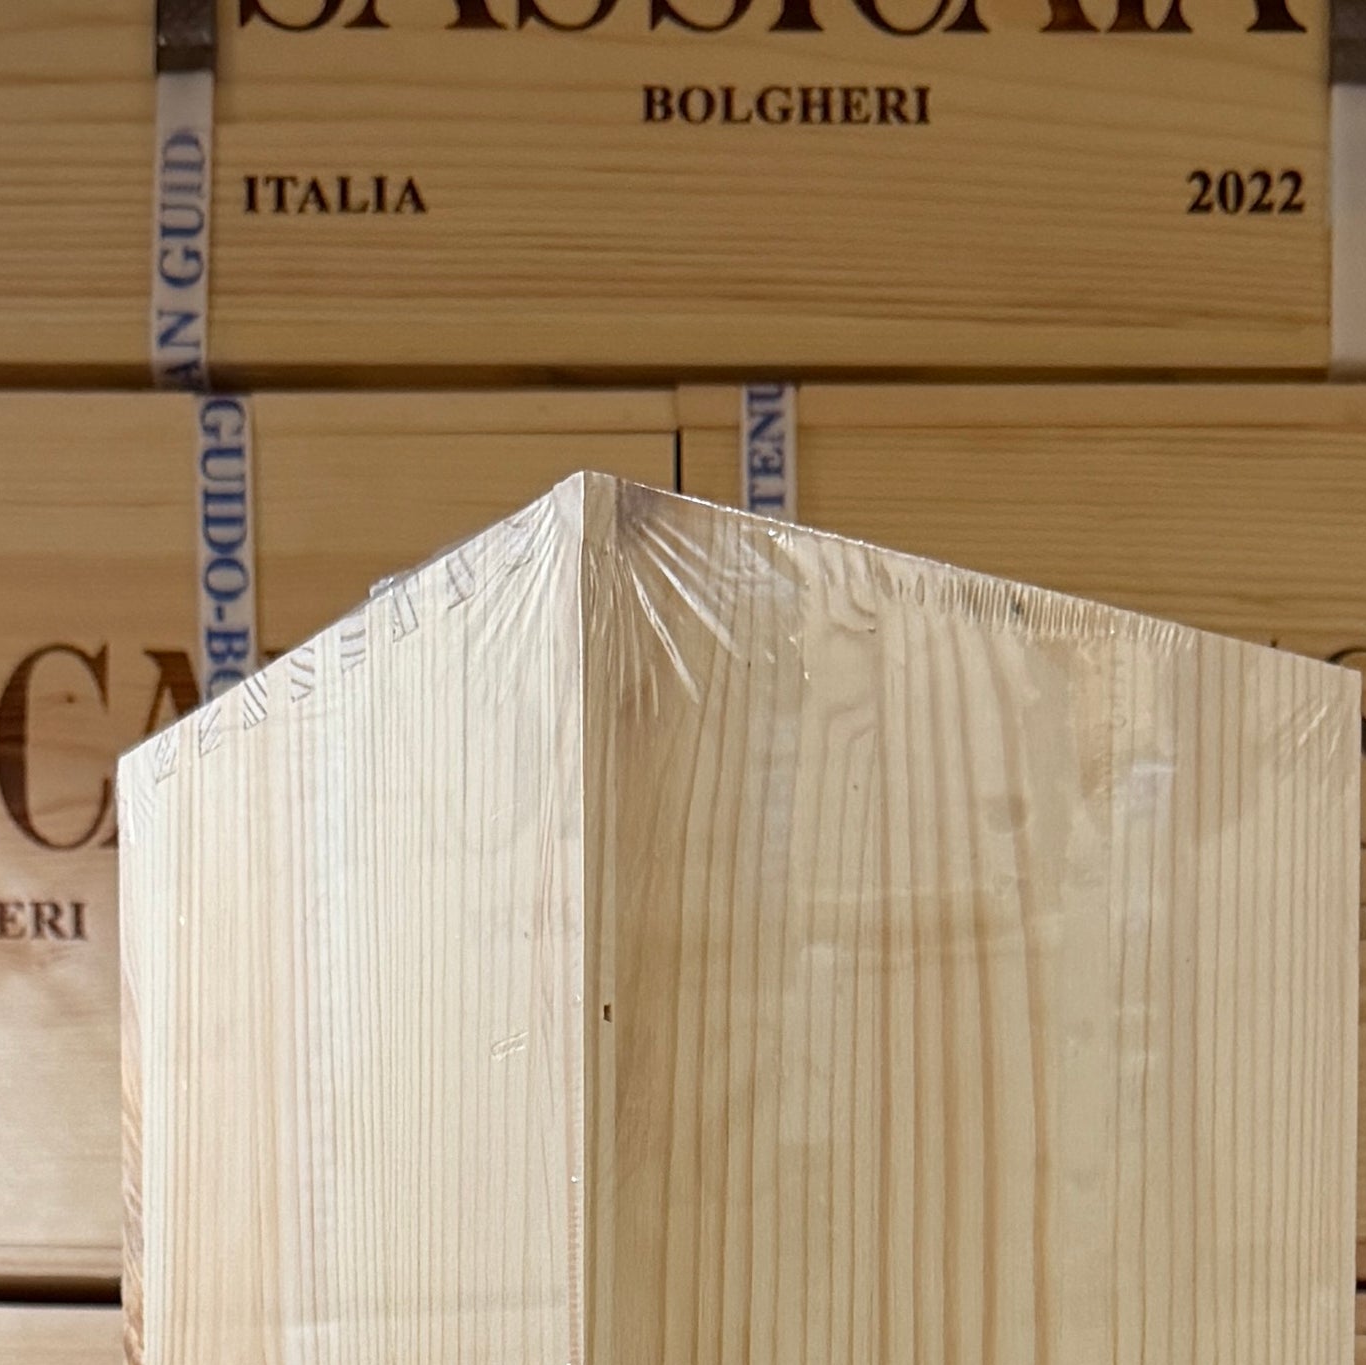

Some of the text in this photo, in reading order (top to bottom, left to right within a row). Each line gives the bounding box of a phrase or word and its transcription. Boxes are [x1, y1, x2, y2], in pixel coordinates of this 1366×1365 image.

[641, 86, 932, 126] BOLGHERI
[243, 175, 428, 215] ITALIA
[1186, 171, 1306, 215] 2022
